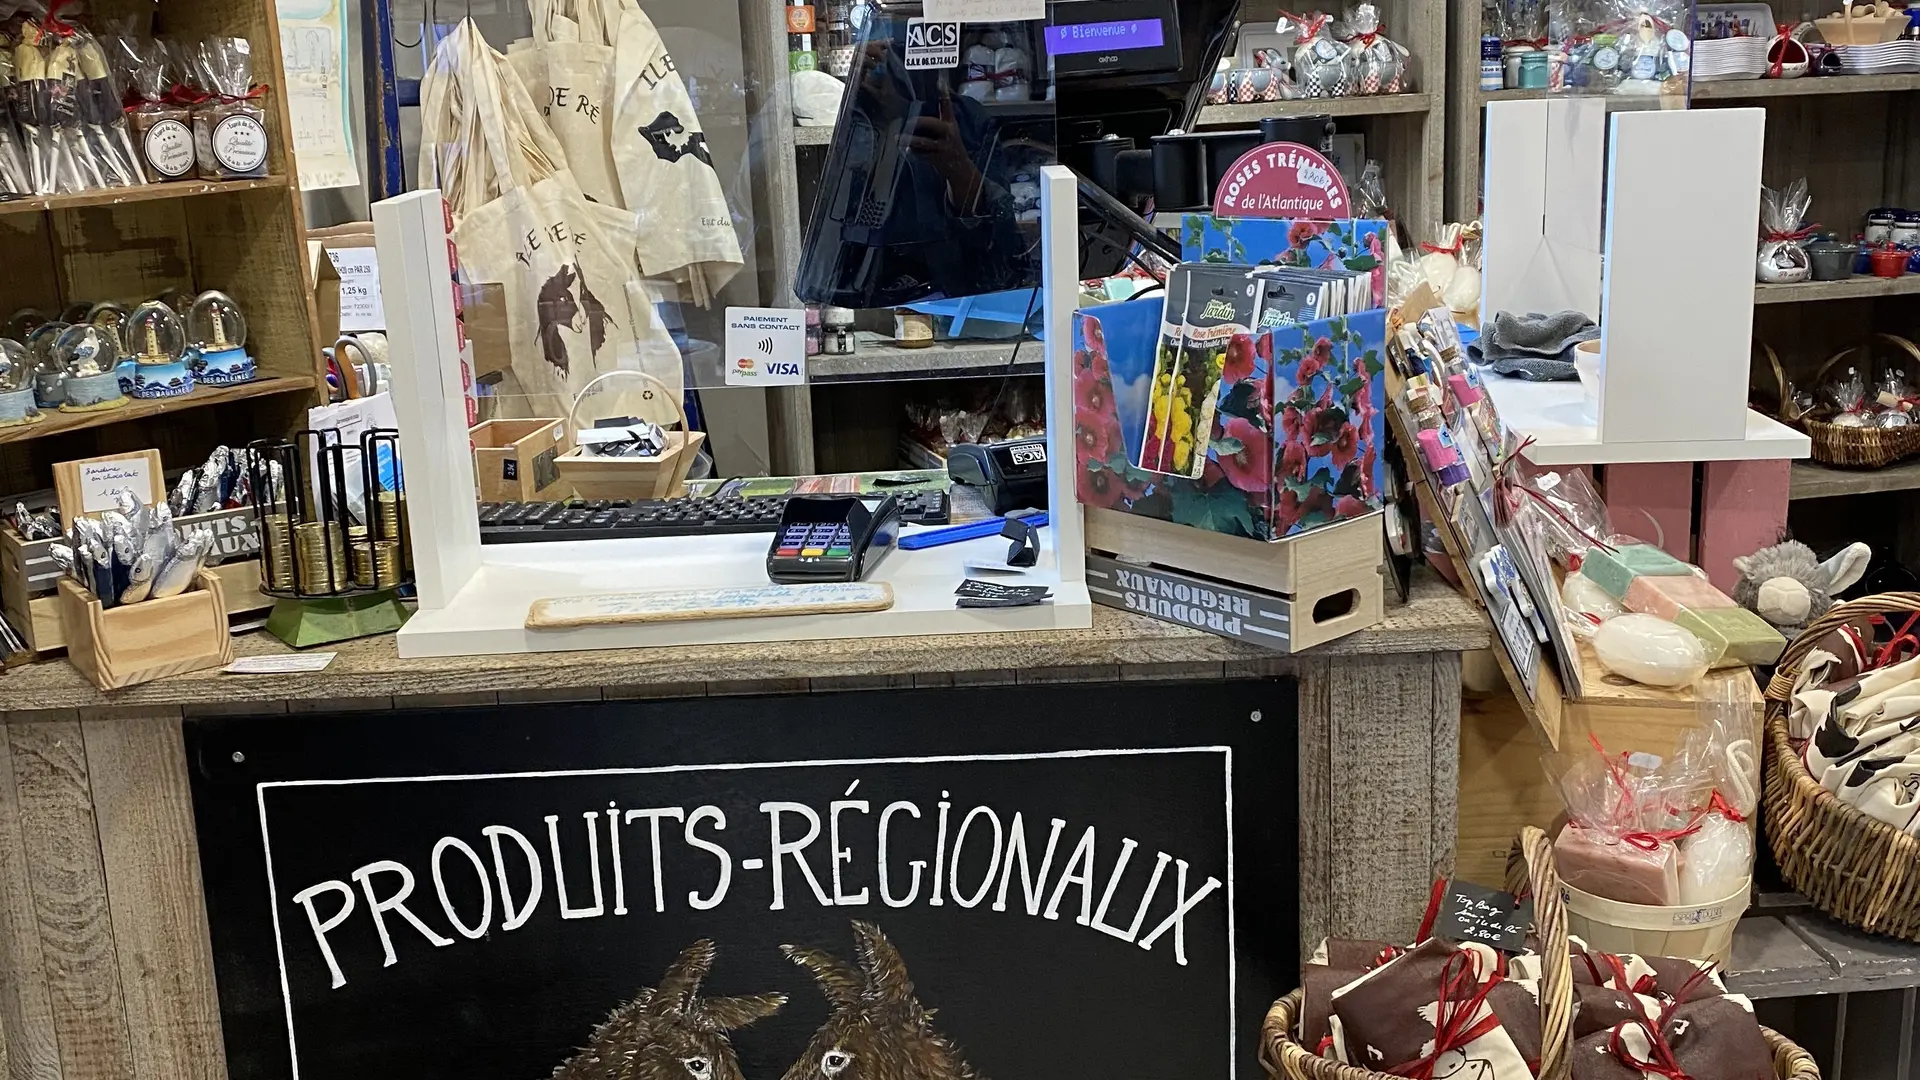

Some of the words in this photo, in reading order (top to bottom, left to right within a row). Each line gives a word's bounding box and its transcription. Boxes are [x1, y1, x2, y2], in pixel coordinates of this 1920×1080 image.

[908, 24, 957, 47] ACS
[1072, 25, 1126, 38] Bienvenue
[639, 53, 676, 91] ILE
[1223, 159, 1261, 208] ROSES
[1241, 194, 1254, 209] de
[1258, 193, 1324, 214] l'Atlantique
[358, 287, 367, 295] kg
[1200, 302, 1236, 321] Jardin
[759, 323, 800, 331] CONTACT
[1192, 328, 1206, 338] Rose
[765, 362, 800, 376] VISA
[103, 469, 139, 480] chocolat
[1116, 569, 1251, 618] REGIONAUX
[1124, 592, 1242, 636] PRODUITS
